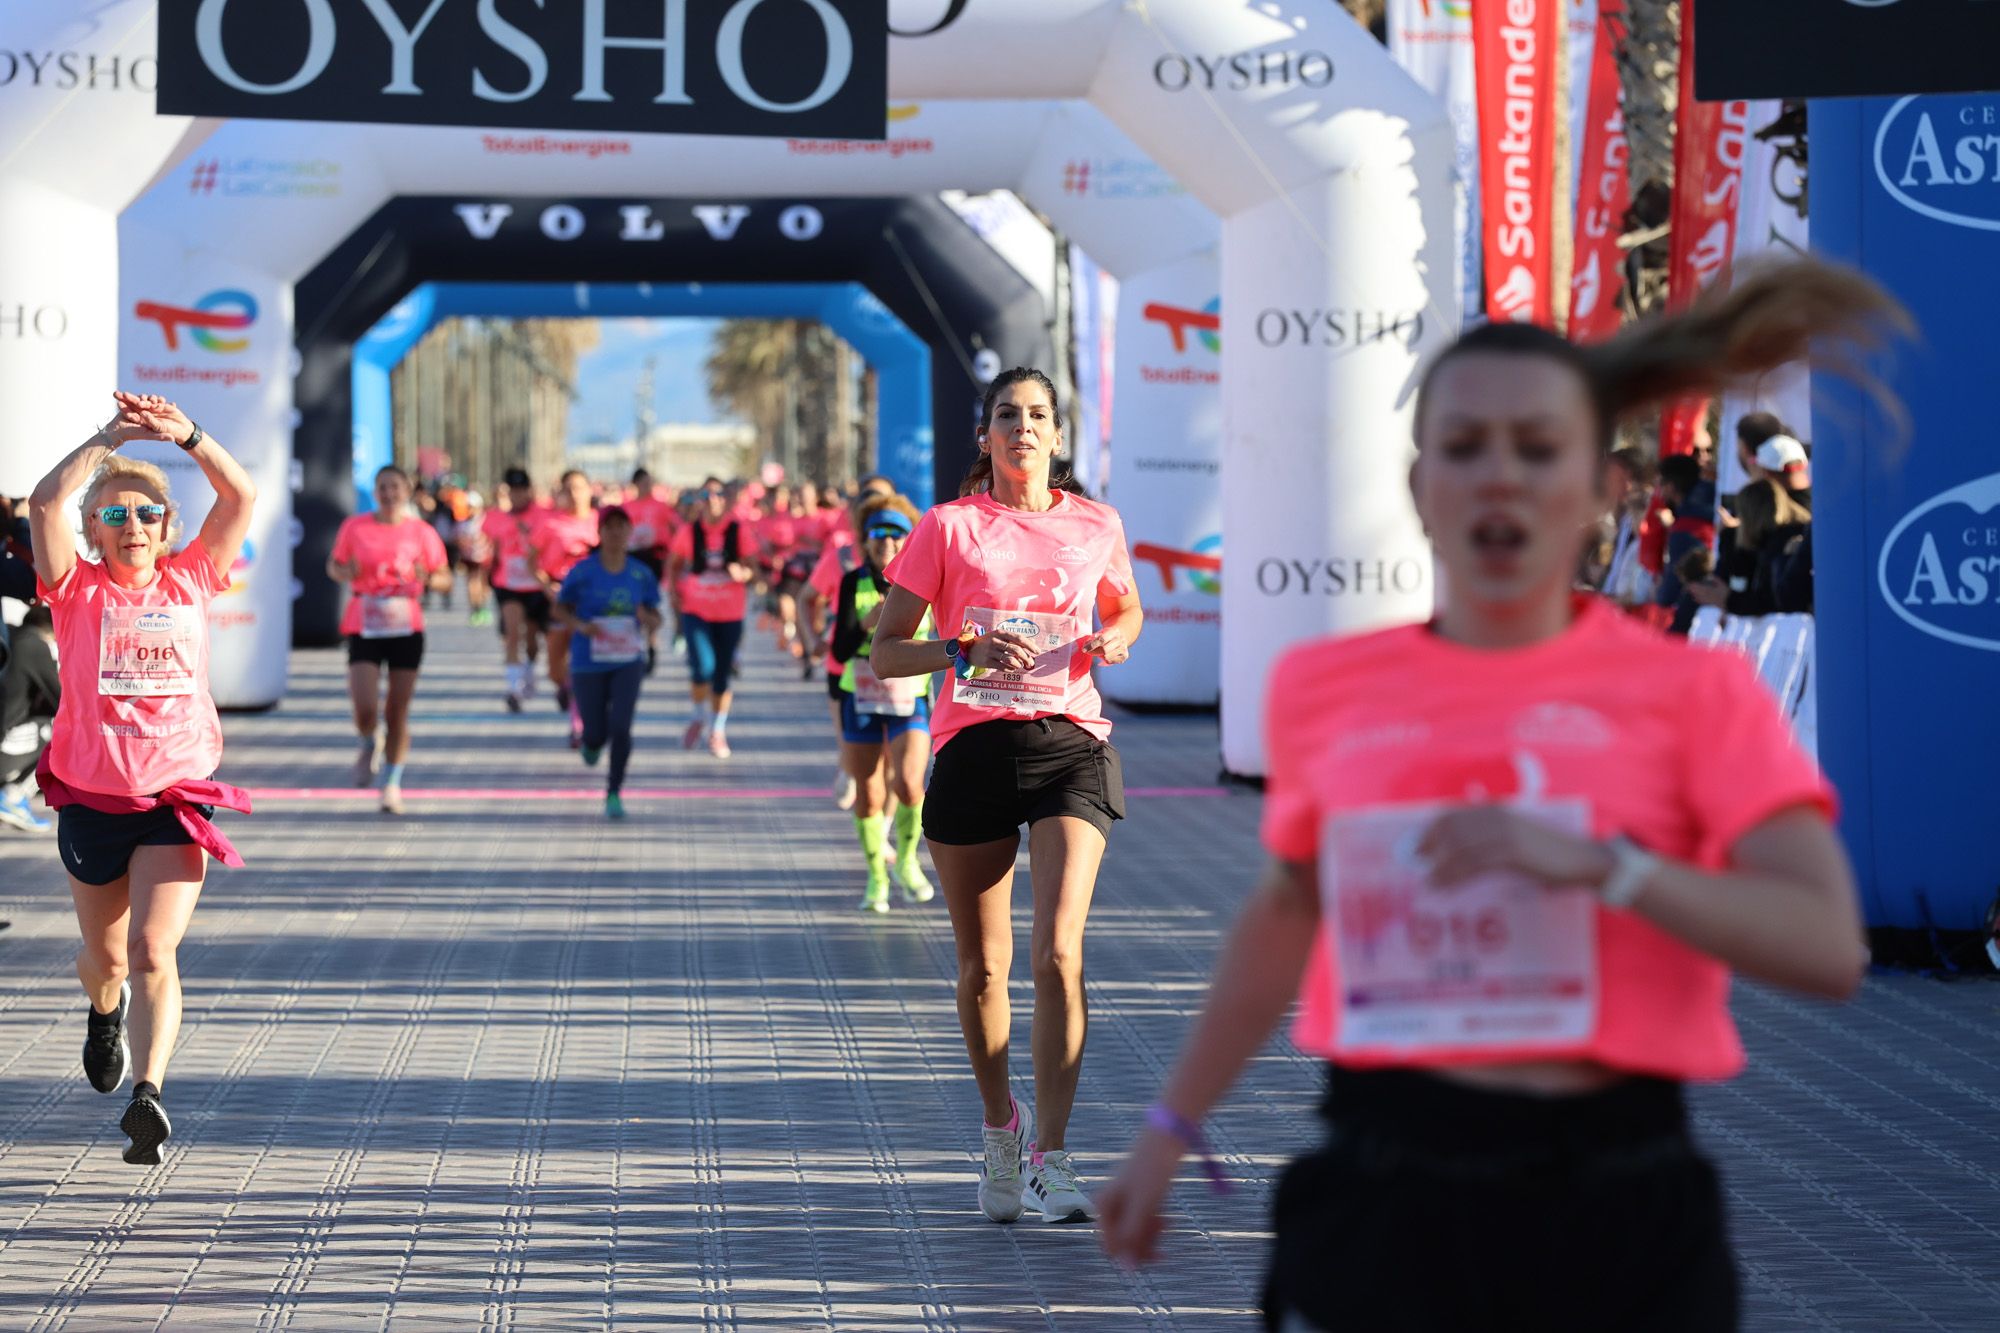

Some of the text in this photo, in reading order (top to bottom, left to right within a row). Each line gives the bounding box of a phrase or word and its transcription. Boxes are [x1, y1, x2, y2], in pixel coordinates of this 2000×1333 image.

[195, 0, 854, 113] OYSHO
[1154, 51, 1335, 91] OYSHO
[455, 204, 824, 241] VOLVO
[1256, 308, 1424, 347] OYSHO
[1256, 558, 1423, 597] OYSHO
[137, 647, 173, 661] 016
[1002, 673, 1020, 681] 1839
[966, 690, 1052, 706] OYSHO Santander
